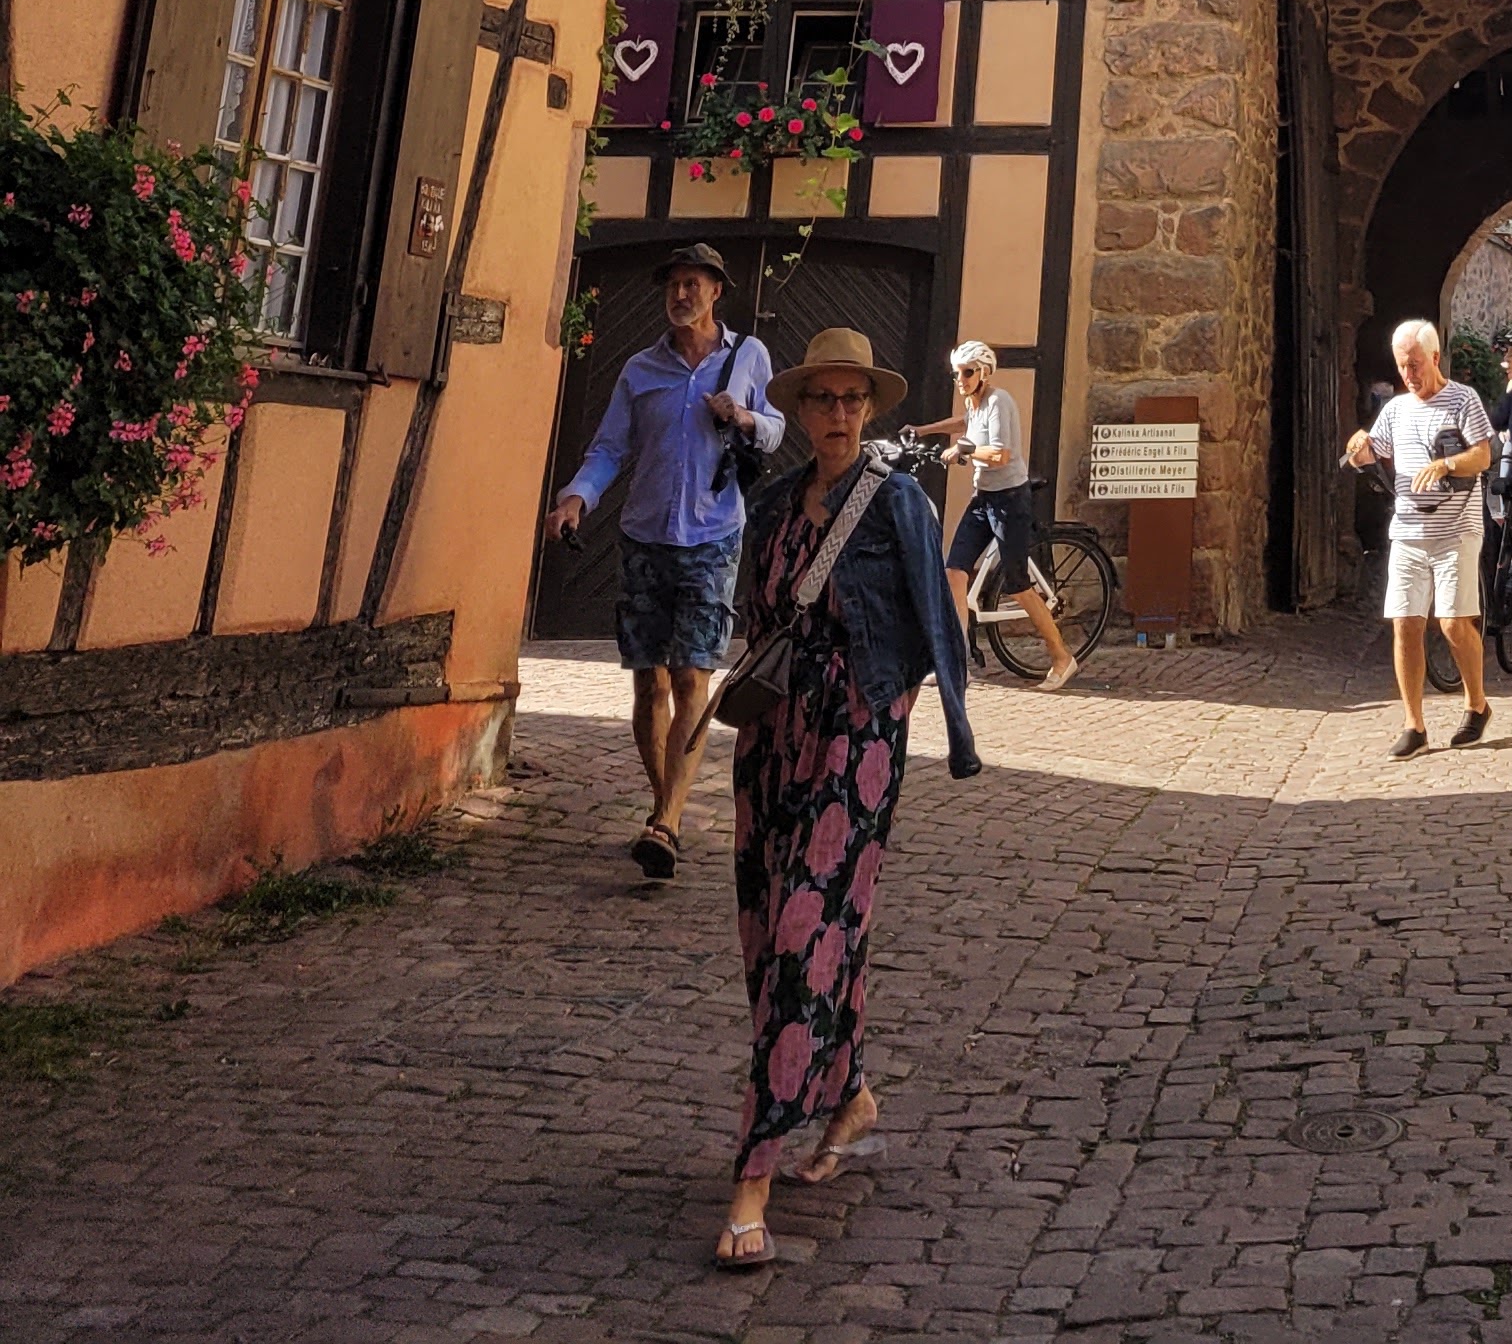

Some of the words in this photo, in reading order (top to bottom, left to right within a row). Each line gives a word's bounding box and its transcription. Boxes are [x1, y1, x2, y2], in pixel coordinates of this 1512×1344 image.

[1112, 428, 1139, 438] Kalinka
[1142, 427, 1176, 437] Artisanat
[1110, 446, 1141, 457] Frédéric
[1143, 446, 1164, 458] Engel
[1166, 446, 1171, 456] &
[1173, 445, 1188, 456] Fils
[1110, 465, 1156, 476] Distillerie
[1159, 465, 1187, 477] Meyer
[1163, 484, 1169, 494] &
[1170, 484, 1185, 494] Fils
